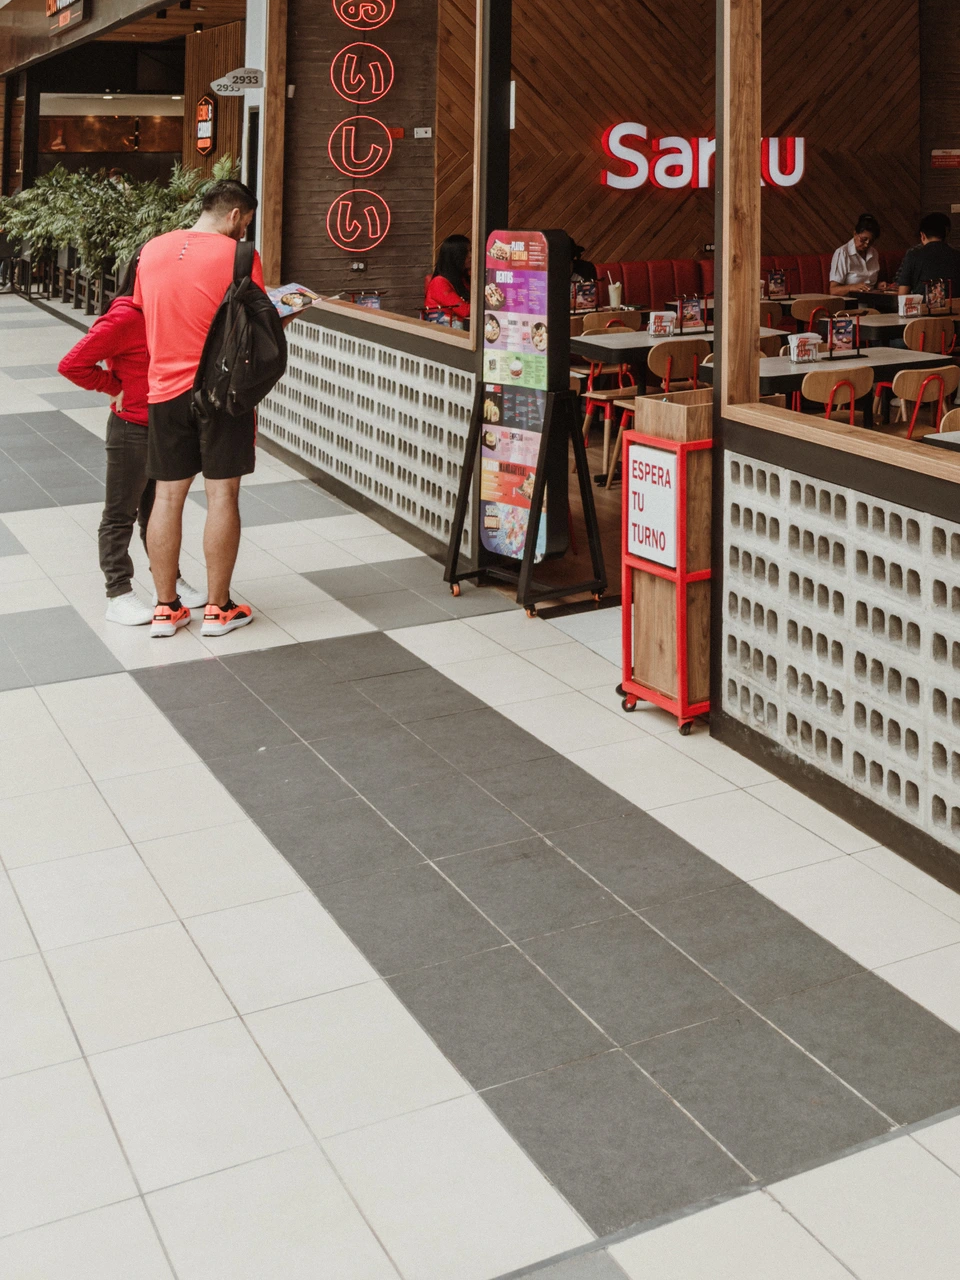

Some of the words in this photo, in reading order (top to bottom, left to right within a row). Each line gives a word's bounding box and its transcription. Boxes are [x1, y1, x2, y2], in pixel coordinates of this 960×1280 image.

[232, 75, 259, 85] 2933
[602, 121, 805, 190] Saru
[632, 459, 672, 489] ESPERA
[632, 491, 645, 512] TU
[632, 522, 666, 551] TURNO
